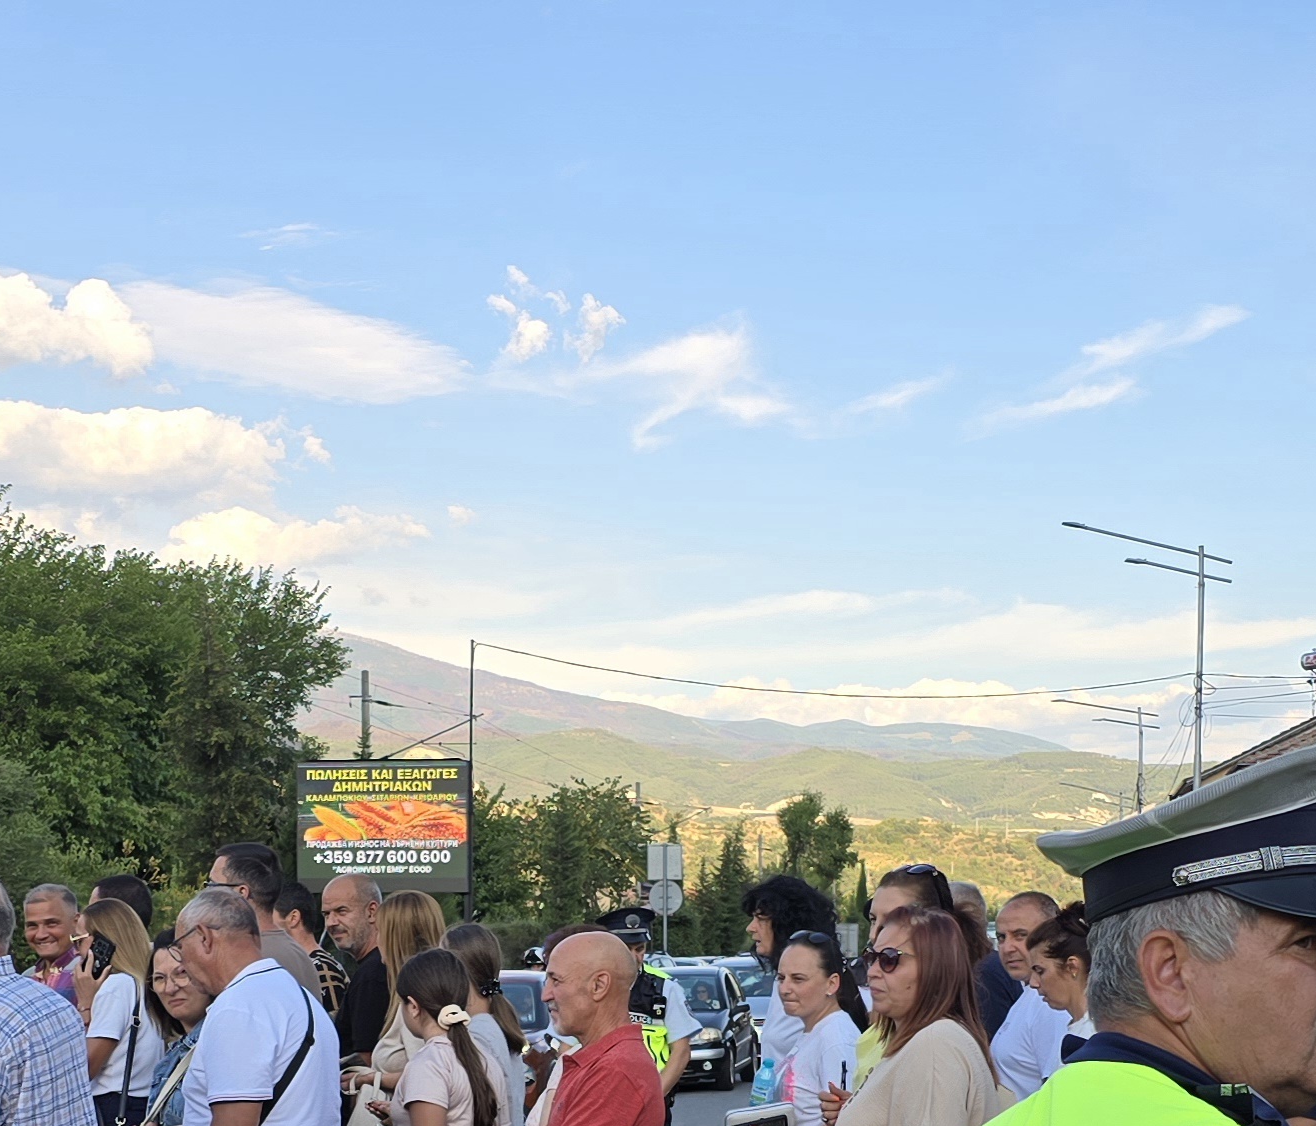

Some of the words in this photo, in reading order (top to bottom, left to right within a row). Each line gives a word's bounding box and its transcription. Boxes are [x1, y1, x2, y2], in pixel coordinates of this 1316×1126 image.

[306, 769, 368, 780] ΠΩΛΗΣΕΙΣ
[372, 769, 393, 780] ΚΑΙ
[397, 768, 458, 779] ΕΞΑΓΩΓΕΣ
[332, 781, 433, 792] ΔΗΜΗΤΡΙΑΚΩΝ
[313, 850, 353, 863] +359
[356, 850, 384, 863] 877
[387, 850, 417, 863] 600
[420, 850, 451, 863] 600
